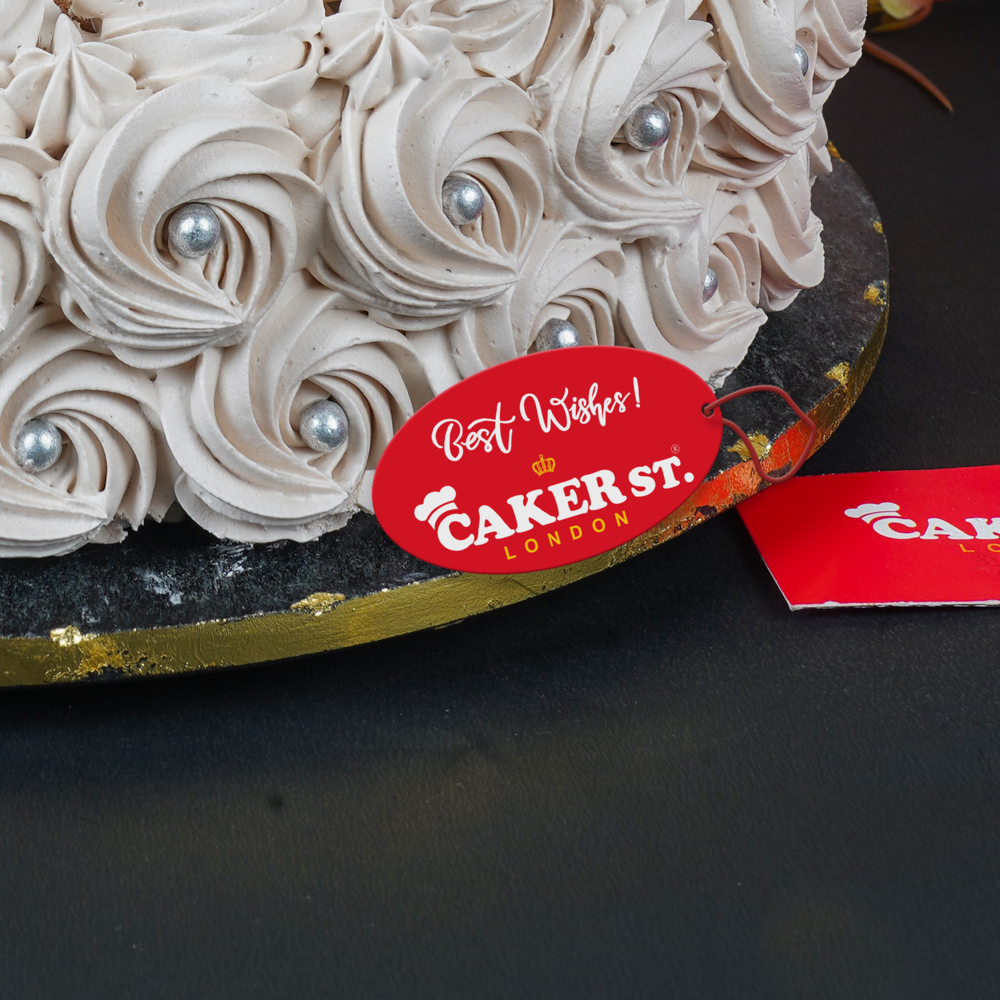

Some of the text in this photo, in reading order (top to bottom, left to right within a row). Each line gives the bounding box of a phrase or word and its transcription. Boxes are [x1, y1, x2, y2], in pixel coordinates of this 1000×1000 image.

[431, 376, 642, 462] Best Wishes!
[437, 455, 695, 552] CAKER ST.
[503, 510, 630, 560] LONDON
